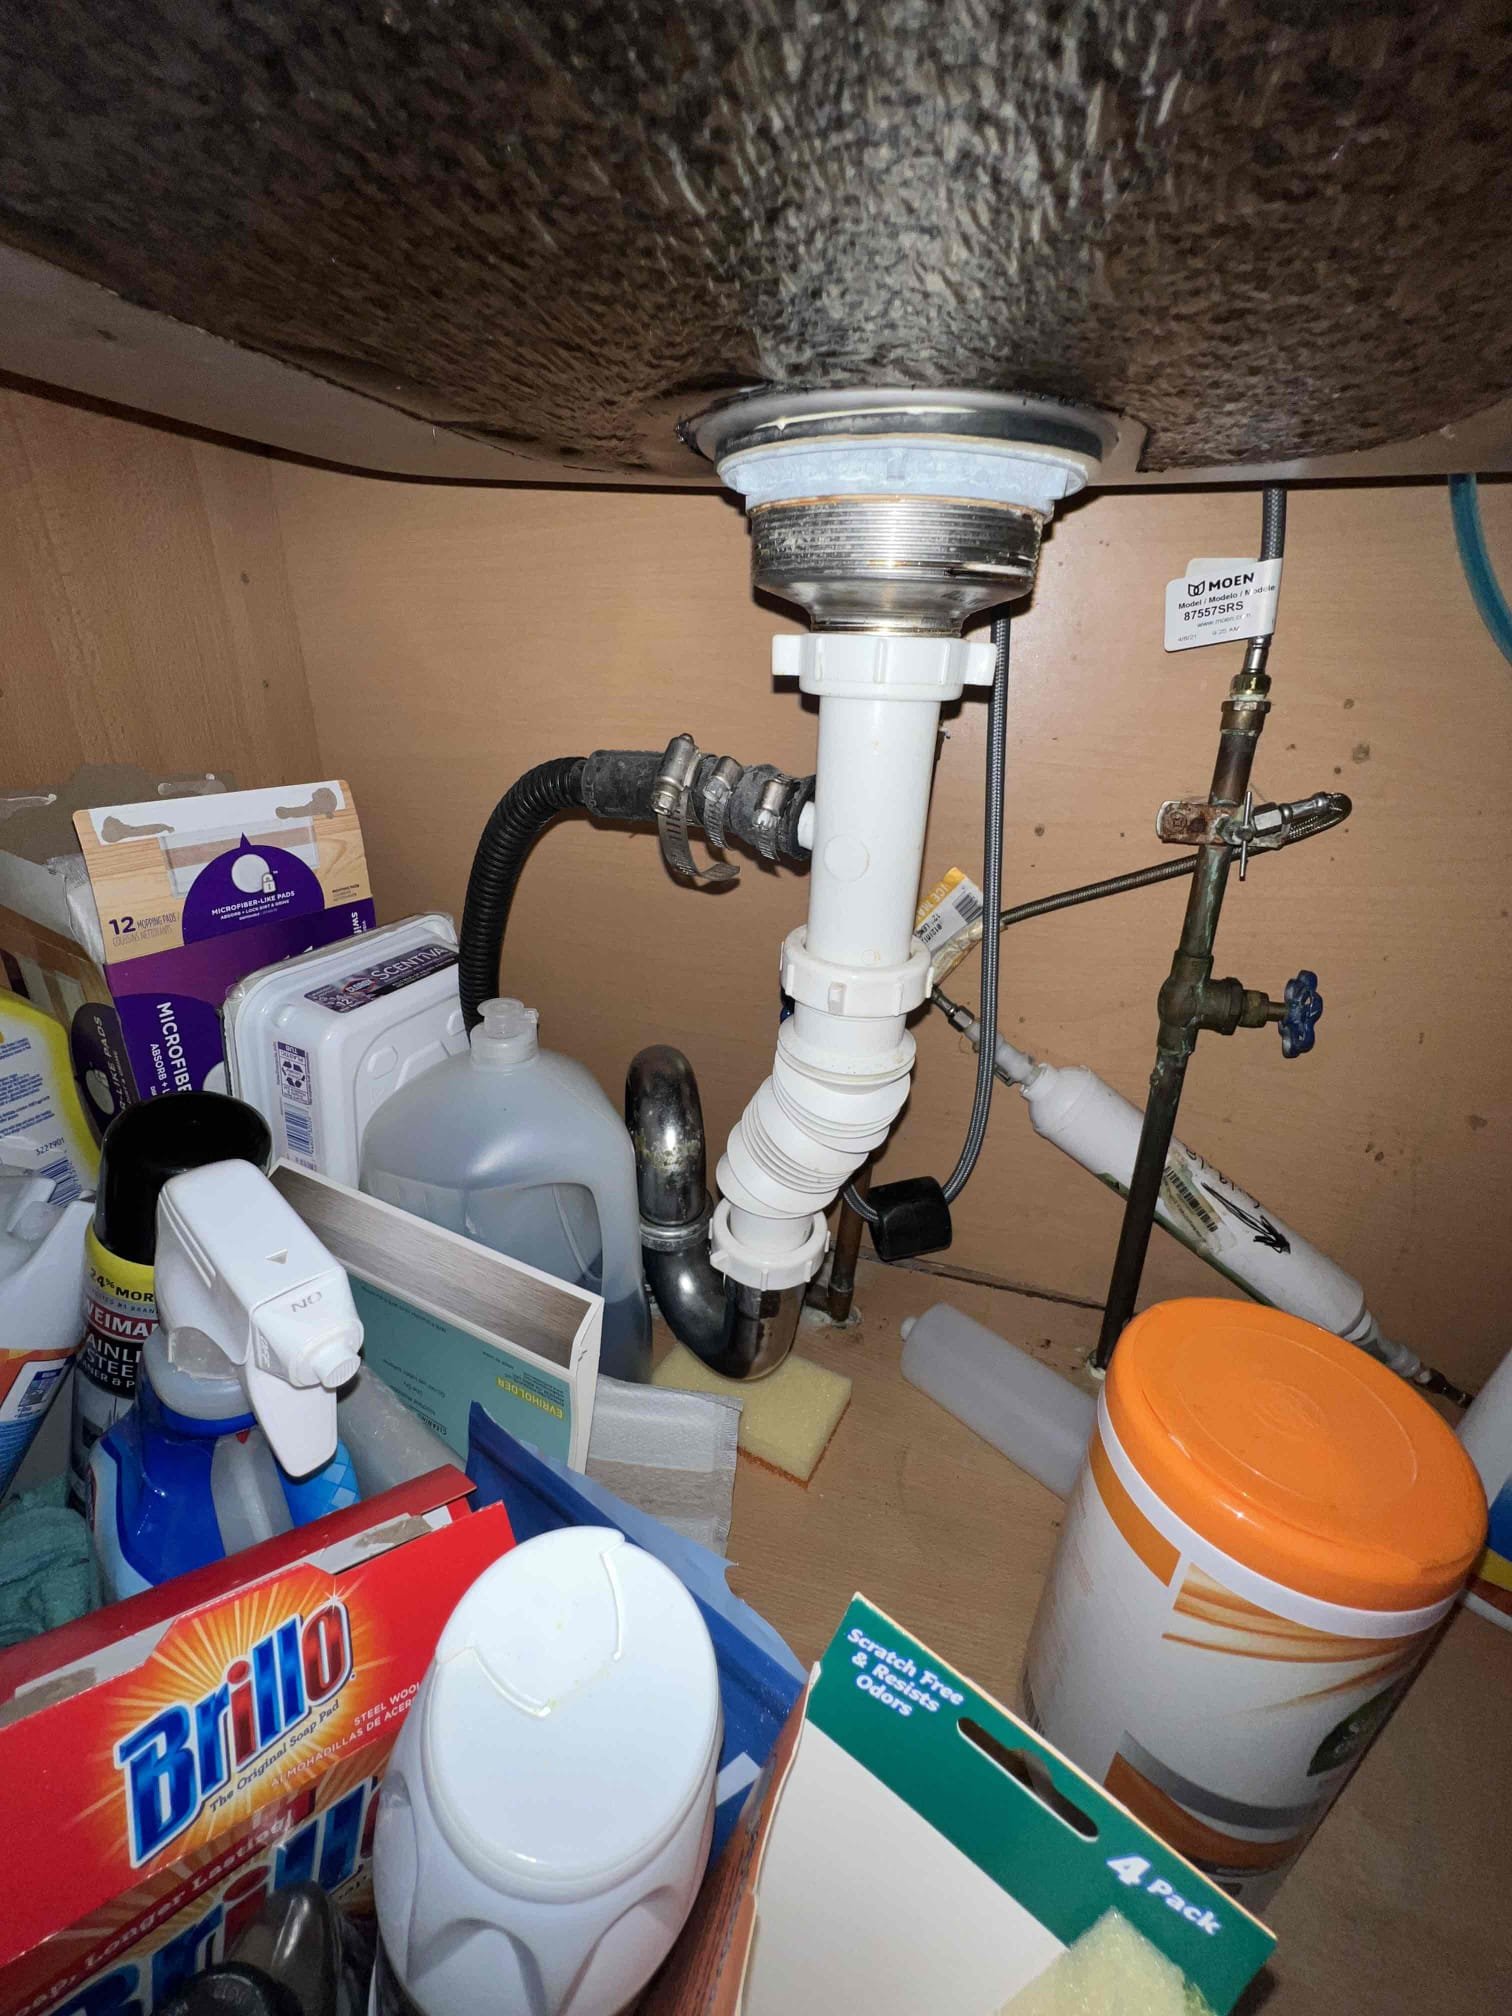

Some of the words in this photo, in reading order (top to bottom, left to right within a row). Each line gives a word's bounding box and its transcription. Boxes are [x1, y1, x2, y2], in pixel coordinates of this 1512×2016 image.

[1178, 599, 1202, 609] Model
[1208, 593, 1238, 603] Modelo
[1208, 572, 1254, 592] MOEN
[1184, 601, 1244, 621] 87557SRS
[108, 916, 136, 935] 12
[137, 914, 163, 929] MOPPING
[162, 911, 177, 924] PADS
[211, 895, 276, 916] MICROFIBER-LIKE
[277, 890, 295, 900] PADS
[371, 947, 447, 980] SCENTIVA
[150, 1043, 168, 1080] ABSORB
[497, 1376, 564, 1420] EVRIHOLDER
[847, 1628, 917, 1678] Scratch
[919, 1670, 964, 1705] Free
[851, 1651, 868, 1669] &
[871, 1663, 940, 1712] Resists
[354, 1702, 387, 1726] STEEL
[856, 1674, 913, 1716] Odors
[114, 1599, 351, 1868] Brillo
[271, 1727, 363, 1787] ALMOHADILLAS
[366, 1716, 381, 1732] DE
[210, 1790, 234, 1812] The
[237, 1742, 287, 1791] Original
[289, 1721, 317, 1748] Soap
[318, 1698, 340, 1723] Pad
[1105, 1855, 1151, 1887] 4
[1146, 1878, 1221, 1936] Pack
[85, 1890, 185, 1967] Longer
